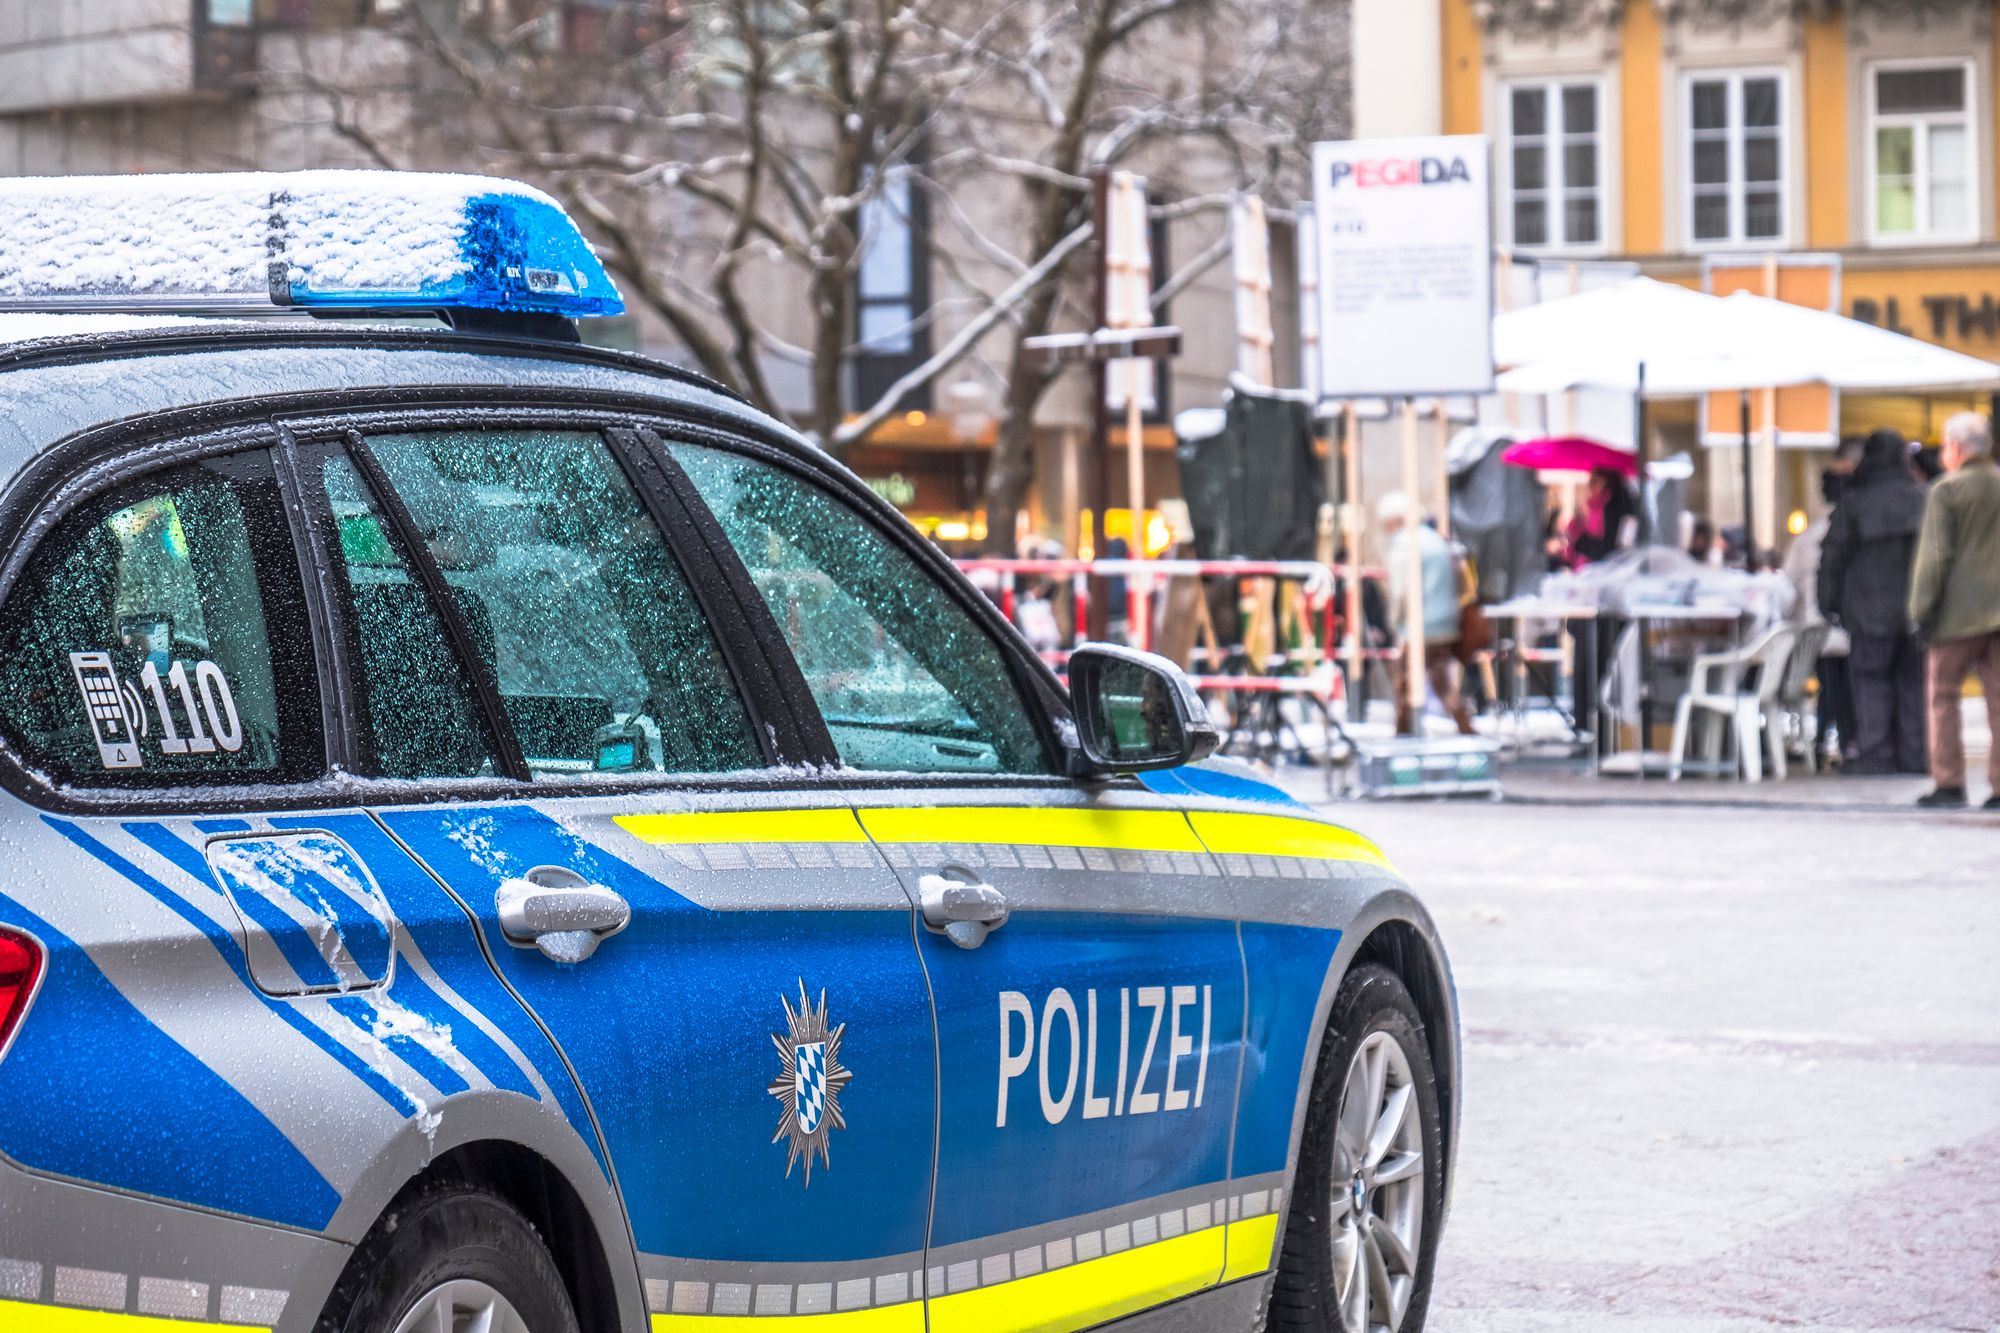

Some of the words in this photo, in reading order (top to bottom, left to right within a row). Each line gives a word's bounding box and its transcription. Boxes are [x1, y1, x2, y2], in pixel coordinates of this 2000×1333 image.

[1331, 156, 1471, 188] PEGIDA
[1921, 292, 2000, 339] TH
[140, 660, 242, 753] 110
[996, 985, 1211, 1127] POLIZEI
